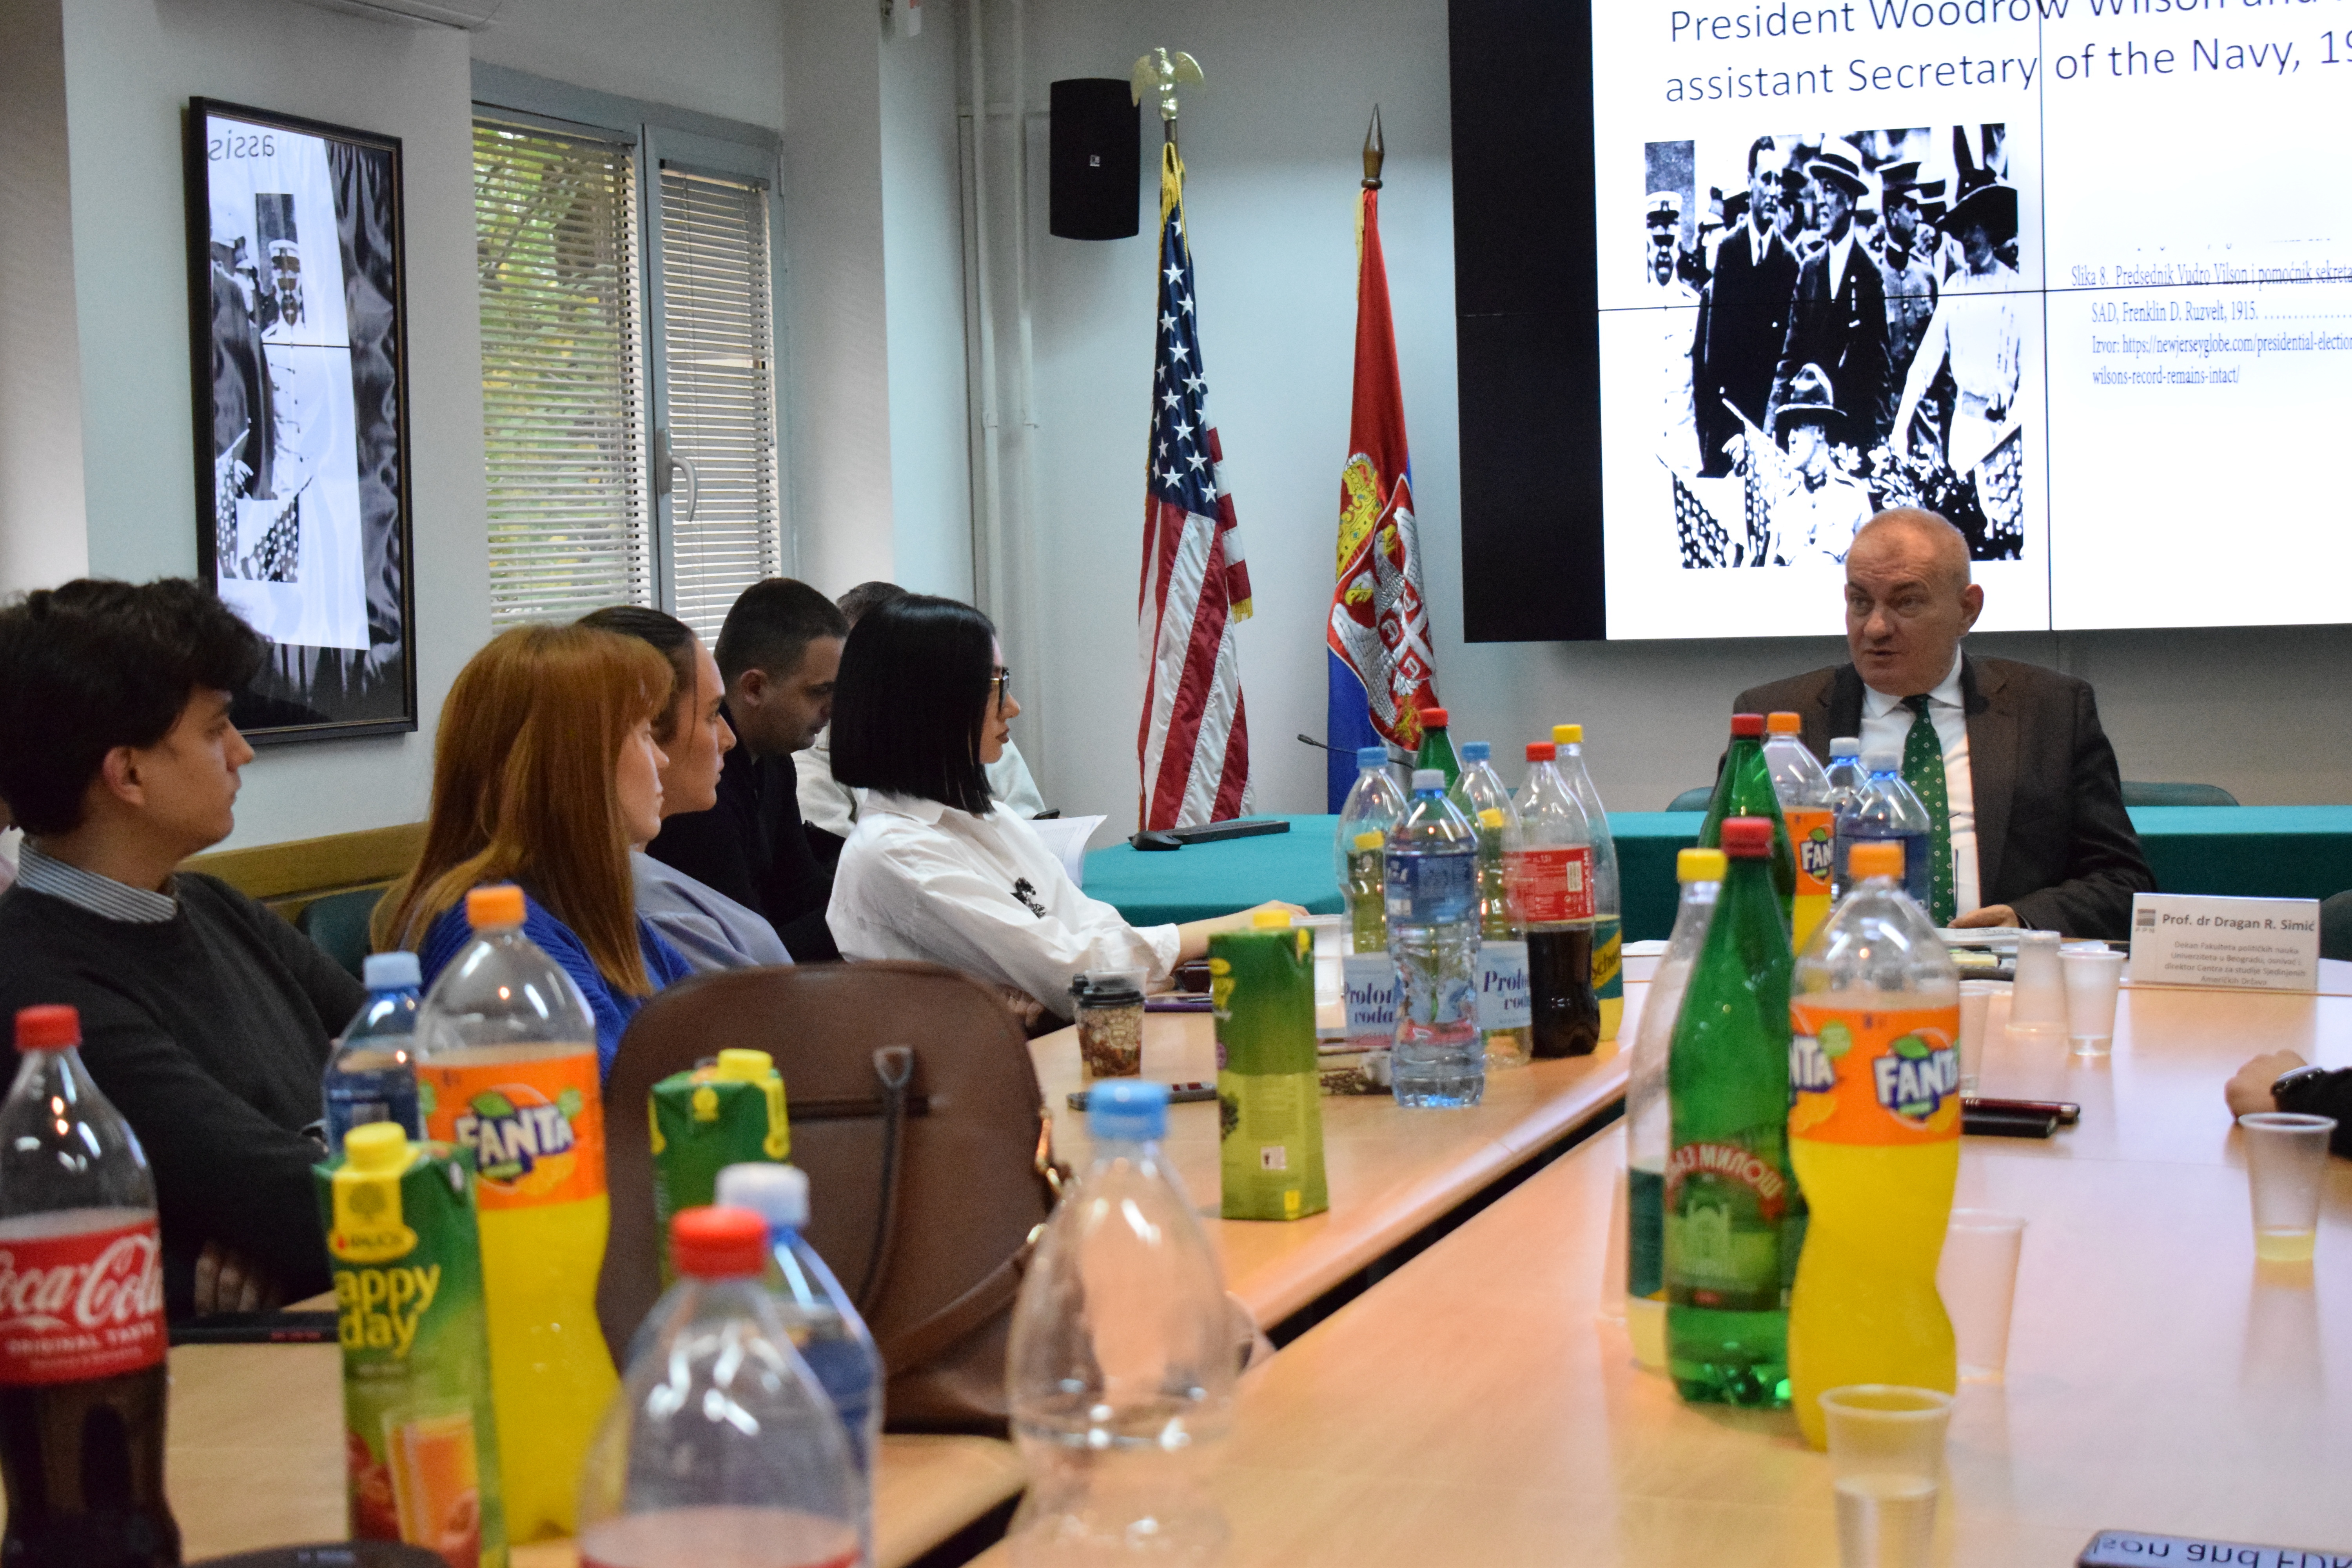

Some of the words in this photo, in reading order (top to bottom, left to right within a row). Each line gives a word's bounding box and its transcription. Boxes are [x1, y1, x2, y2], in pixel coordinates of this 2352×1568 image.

[1672, 2, 1855, 42] President
[1869, 0, 2068, 29] Woodrow
[1666, 64, 1833, 102] assistant
[1849, 56, 2037, 91] Secretary
[2056, 44, 2095, 79] of
[2108, 41, 2174, 76] the
[2193, 38, 2299, 76] Navy,
[2072, 265, 2096, 286] Slika
[2100, 266, 2108, 285] 8.
[2116, 263, 2174, 285] Predsednik
[2178, 263, 2210, 285] Vudro
[2214, 262, 2247, 285] Vilson
[2252, 263, 2254, 285] i
[2258, 260, 2312, 291] pomoćnik
[2092, 302, 2119, 325] SAD,
[2123, 301, 2166, 321] Frenklin
[2170, 301, 2181, 321] D.
[2185, 299, 2227, 323] Ruzvelt,
[2232, 301, 2258, 320] 1915.
[2092, 336, 2119, 353] Izvor:
[2092, 365, 2240, 384] wilsons-record-remains-intact/
[2162, 914, 2192, 925] Prof.
[2197, 915, 2210, 926] dr
[2214, 916, 2260, 930] Dragan
[2264, 919, 2276, 929] R.
[2280, 920, 2314, 932] Simić
[2201, 942, 2236, 951] Fakulteta
[456, 1105, 573, 1165] FANTA
[338, 1306, 419, 1359] day
